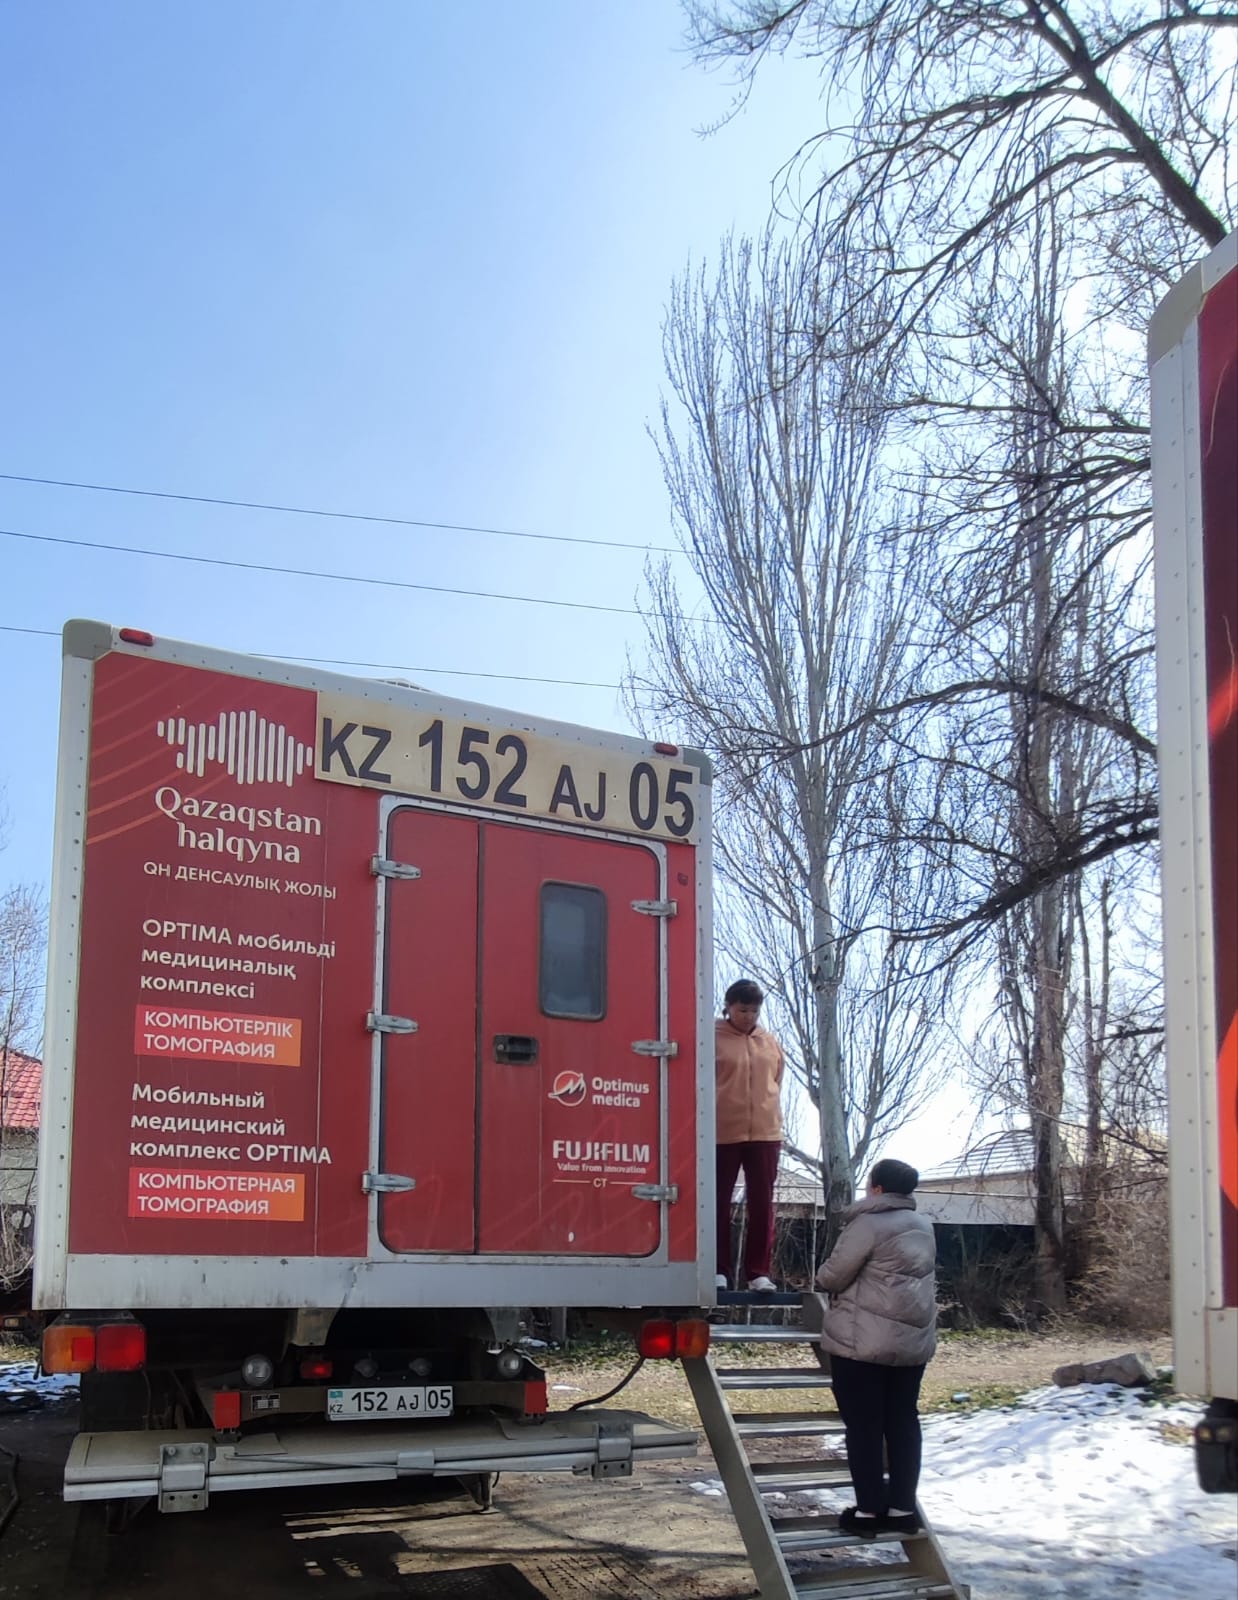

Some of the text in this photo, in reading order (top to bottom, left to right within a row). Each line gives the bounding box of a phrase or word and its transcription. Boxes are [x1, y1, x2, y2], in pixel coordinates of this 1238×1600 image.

[321, 717, 694, 837] KZ 152 AJ 05
[155, 786, 321, 836] Qazaqstan
[176, 821, 301, 864] halqyna
[174, 865, 281, 894] ДЕНСАУЛЫҚ
[284, 880, 337, 900] ЖОЛЫ
[142, 918, 336, 960] OPTIMA мобильді
[141, 949, 297, 980] медициналық
[140, 975, 255, 999] комплексі
[144, 1010, 293, 1038] КОМПЬЮТЕРЛІК
[143, 1033, 276, 1058] ТОМОГРАФИЯ
[131, 1083, 265, 1109] Мобильный
[592, 1077, 650, 1094] Optimus
[592, 1094, 641, 1108] medica
[130, 1115, 285, 1136] медицинский
[130, 1142, 332, 1164] комплекс OPTIMA
[552, 1140, 650, 1163] FUJIFILM
[557, 1162, 647, 1174] Value from innovation
[138, 1172, 295, 1193] КОМПЬЮТЕРНАЯ
[137, 1196, 269, 1215] ТОМОГРАФИЯ
[329, 1403, 344, 1413] KZ
[351, 1389, 451, 1412] 152 AJ 05
